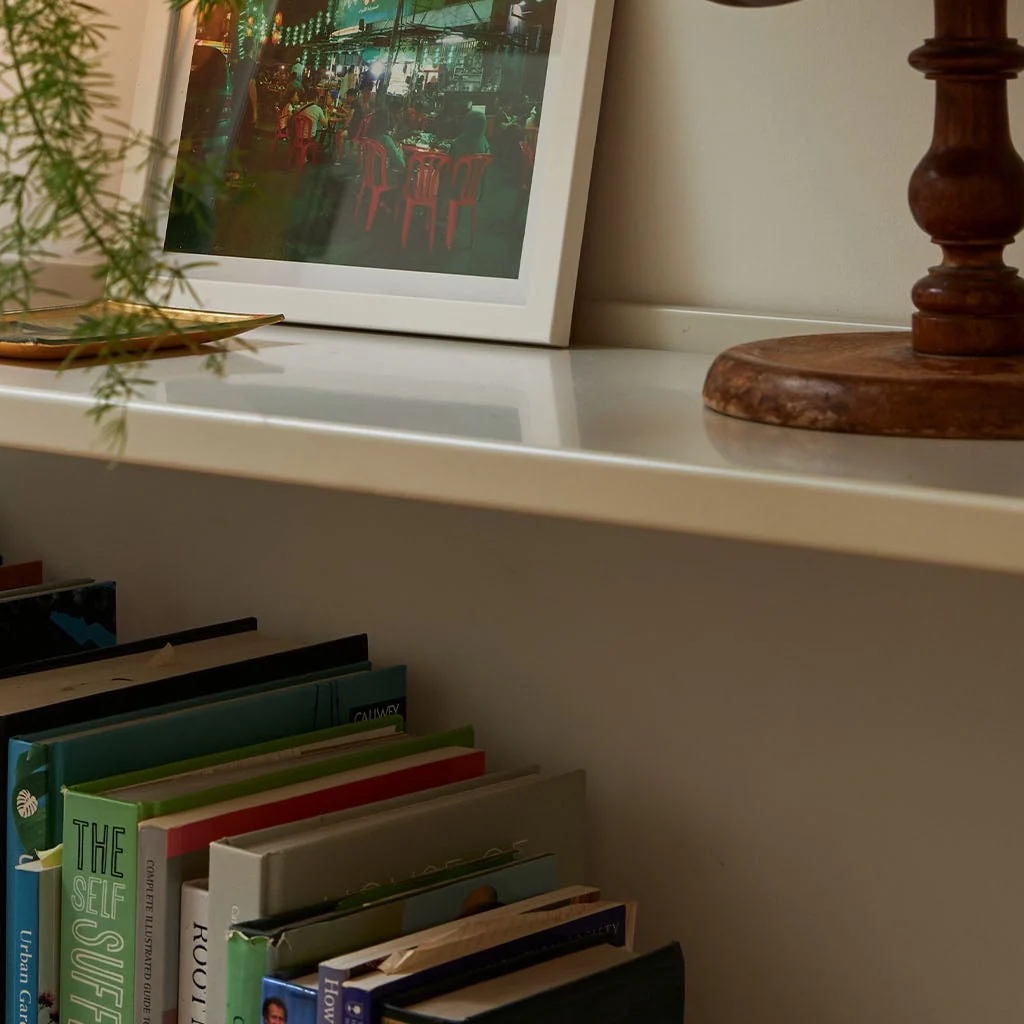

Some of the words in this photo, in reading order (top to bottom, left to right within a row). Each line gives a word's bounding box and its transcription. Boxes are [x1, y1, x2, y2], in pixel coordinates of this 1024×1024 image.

[73, 819, 126, 879] THE
[71, 875, 126, 920] SELF
[145, 860, 155, 913] COMPLETE
[19, 929, 33, 984] Urban
[144, 915, 154, 980] ILLUSTRATED
[143, 983, 152, 1014] GUIDE
